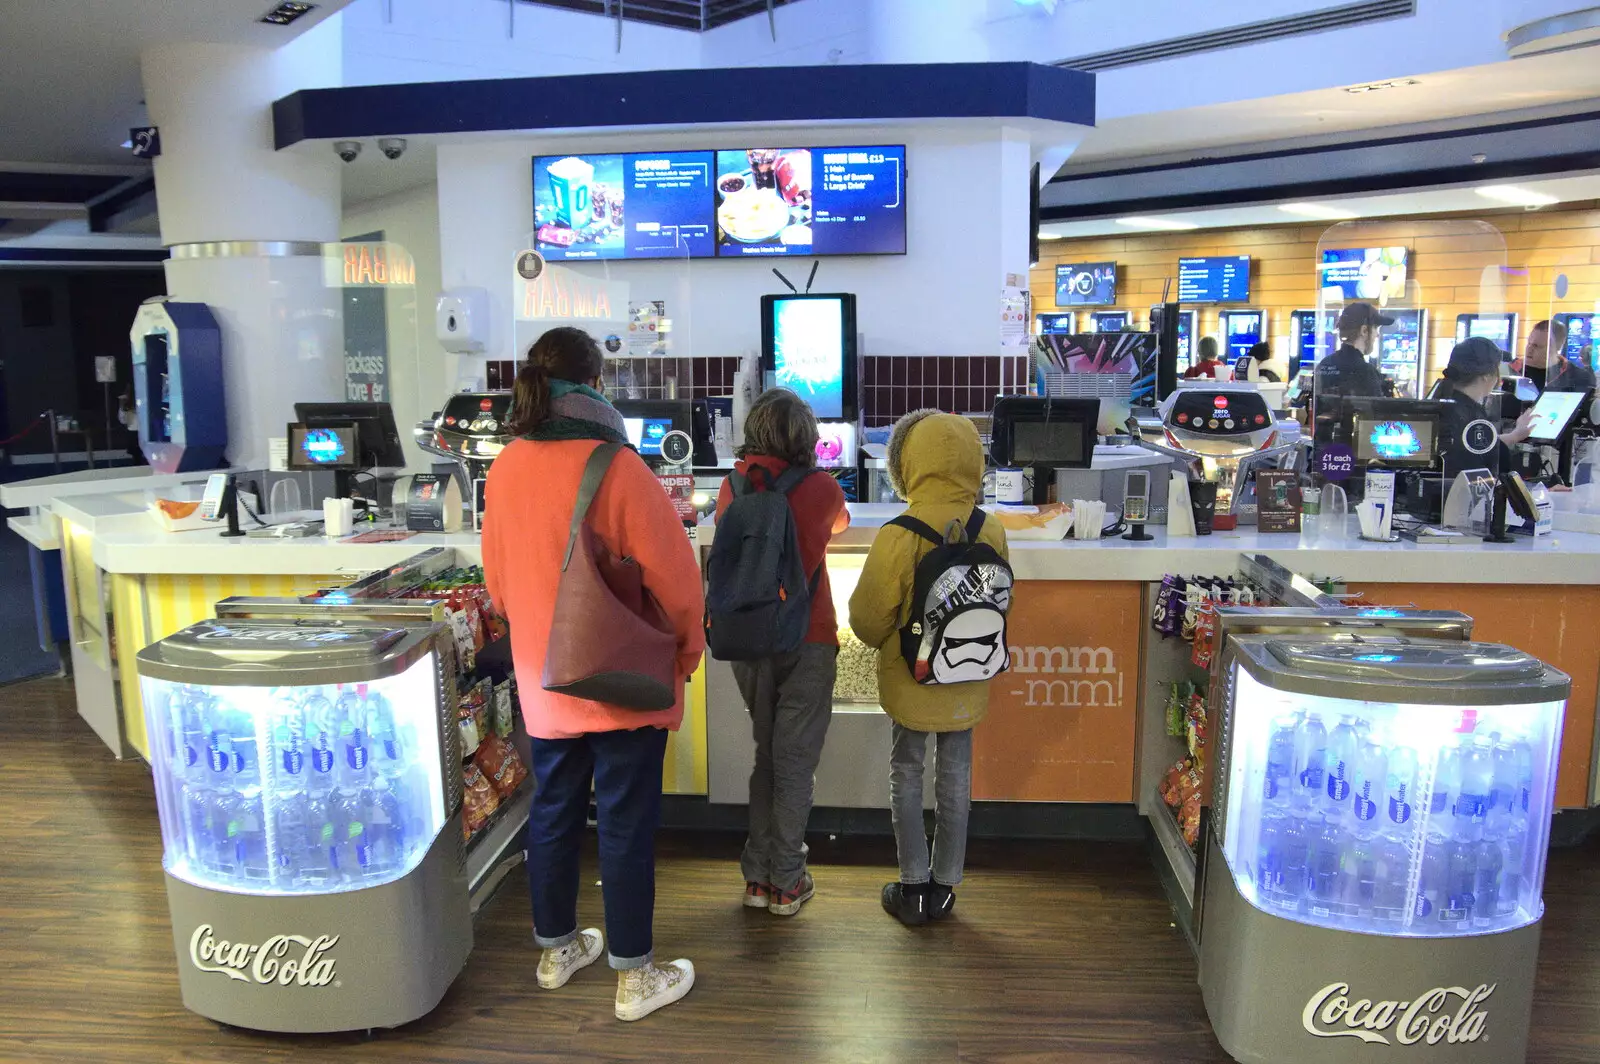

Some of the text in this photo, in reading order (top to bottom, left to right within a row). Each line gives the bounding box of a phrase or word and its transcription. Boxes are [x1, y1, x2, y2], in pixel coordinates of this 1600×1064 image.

[345, 351, 384, 379] jackass
[1322, 453, 1332, 462] £1
[1322, 463, 1351, 471] 3 for £2
[1334, 760, 1346, 800] smartwater
[1361, 780, 1371, 821] smartwater
[1395, 783, 1407, 823] smartwater
[190, 923, 341, 987] Coca-Cola
[1302, 982, 1498, 1046] Coca-Cola
